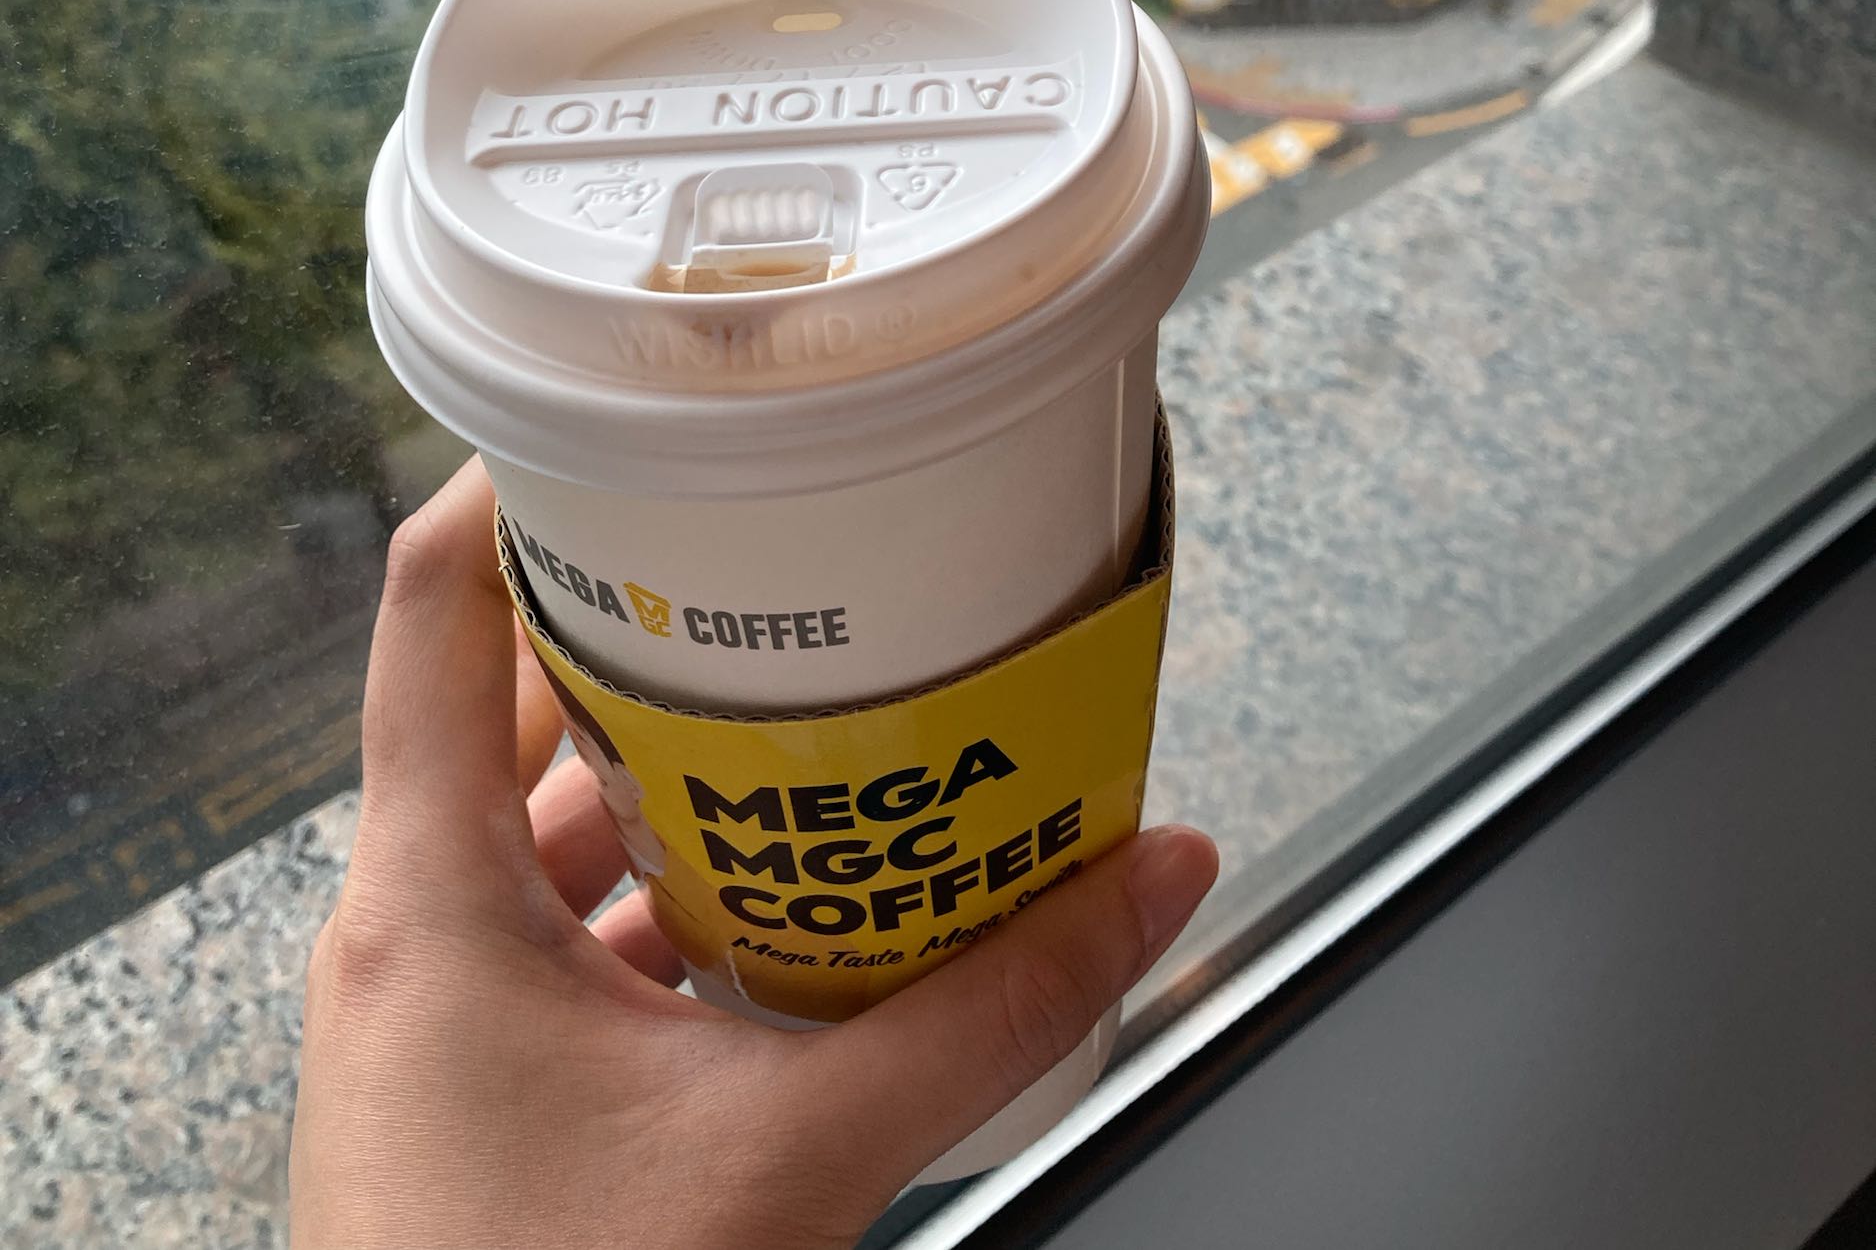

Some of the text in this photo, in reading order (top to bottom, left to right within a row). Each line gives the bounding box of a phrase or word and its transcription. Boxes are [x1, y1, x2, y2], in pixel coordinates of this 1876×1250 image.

[490, 95, 657, 140] HOT
[712, 70, 1076, 125] CAUTION
[897, 141, 937, 160] PS
[512, 517, 631, 624] MEGA
[683, 607, 850, 650] COFFEE
[683, 738, 1018, 833] MEGA
[699, 816, 958, 885] MGC
[718, 798, 1083, 937] COFFEE
[731, 936, 820, 967] Mega
[827, 949, 905, 969] Taste
[917, 912, 1003, 958] Mega
